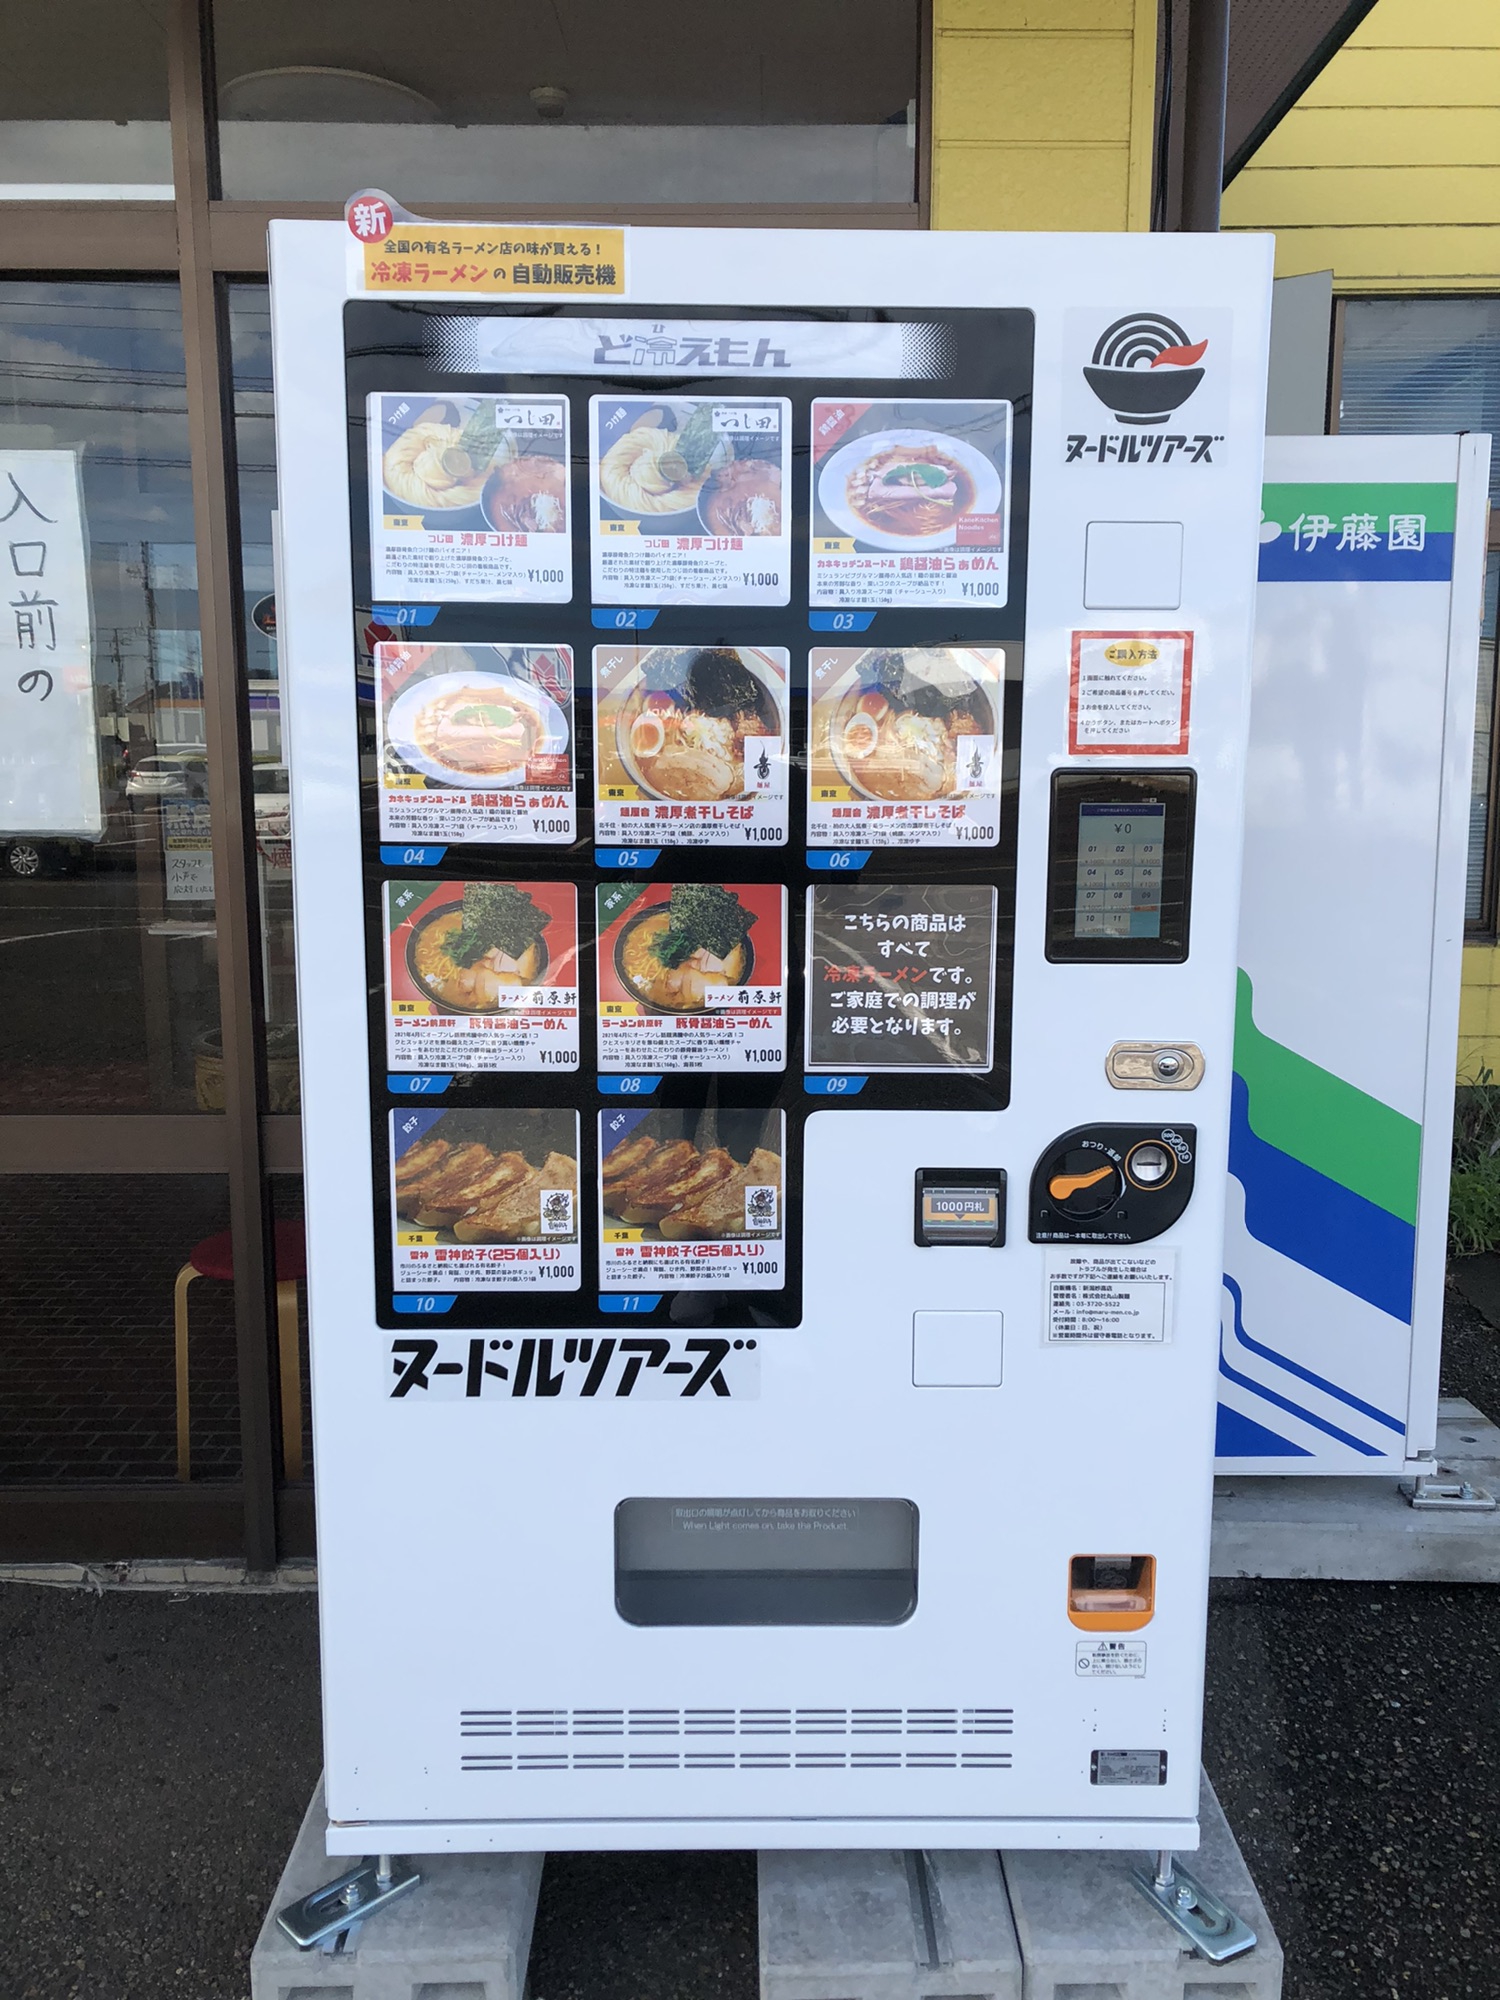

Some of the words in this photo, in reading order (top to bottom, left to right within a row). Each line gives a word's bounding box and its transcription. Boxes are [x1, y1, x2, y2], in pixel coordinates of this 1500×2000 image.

[354, 203, 387, 236] 新
[384, 240, 601, 256] 全国の有名ラーメン店の味が買える！
[1065, 435, 1225, 463] ヌードルツアーズ
[1289, 513, 1426, 552] 伊藤園
[461, 533, 528, 547] 濃厚つけ麺
[677, 538, 743, 551] 濃厚つけ麺
[817, 560, 896, 568] カネキッチンヌードル
[900, 557, 999, 571] 鶏醤油らぁめん
[527, 569, 564, 583] ¥1,000
[743, 572, 779, 586] ¥1,000
[961, 582, 999, 596] ¥1,000
[396, 608, 417, 624] 01
[615, 612, 637, 628] 02
[833, 614, 854, 630] 03
[599, 655, 623, 678] 煮干し
[389, 795, 467, 804] カネキッチンヌードル
[471, 793, 569, 808] 鶏醤油らぁめん
[655, 806, 754, 819] 濃厚煮干しそば
[867, 805, 966, 819] 濃厚煮干しそば
[533, 819, 570, 834] ¥1,000
[956, 826, 994, 841] ¥1,000
[745, 827, 782, 841] ¥1,000
[403, 849, 425, 864] 04
[618, 851, 639, 866] 05
[829, 853, 850, 868] 06
[844, 914, 967, 932] こちらの商品は
[877, 940, 931, 958] すべて
[823, 965, 973, 984] 冷凍ラーメンです。
[500, 994, 528, 1002] ラーメン
[707, 994, 734, 1002] ラーメン
[830, 991, 976, 1010] ご家庭での調理が
[469, 1017, 567, 1030] 豚骨醤油らーめん
[676, 1017, 773, 1029] 豚骨醤油らーめん
[831, 1017, 962, 1035] 必要となります。
[539, 1050, 577, 1064] ¥1,000
[745, 1049, 782, 1063] ¥1,000
[410, 1078, 431, 1092] 07
[620, 1078, 641, 1092] 08
[826, 1078, 847, 1092] 09
[402, 1116, 419, 1133] 餃子
[609, 1113, 626, 1131] 餃子
[936, 1202, 984, 1211] 1000円札
[410, 1251, 429, 1259] 雷神
[615, 1248, 634, 1256] 雷神
[539, 1265, 574, 1279] ¥1,000
[742, 1261, 778, 1275] ¥1,000
[416, 1297, 435, 1311] 10
[622, 1297, 640, 1310] 11
[390, 1338, 757, 1397] ヌードルツアーズ
[683, 1521, 707, 1530] When
[709, 1521, 730, 1532] Light
[777, 1522, 795, 1530] take
[797, 1522, 811, 1530] the
